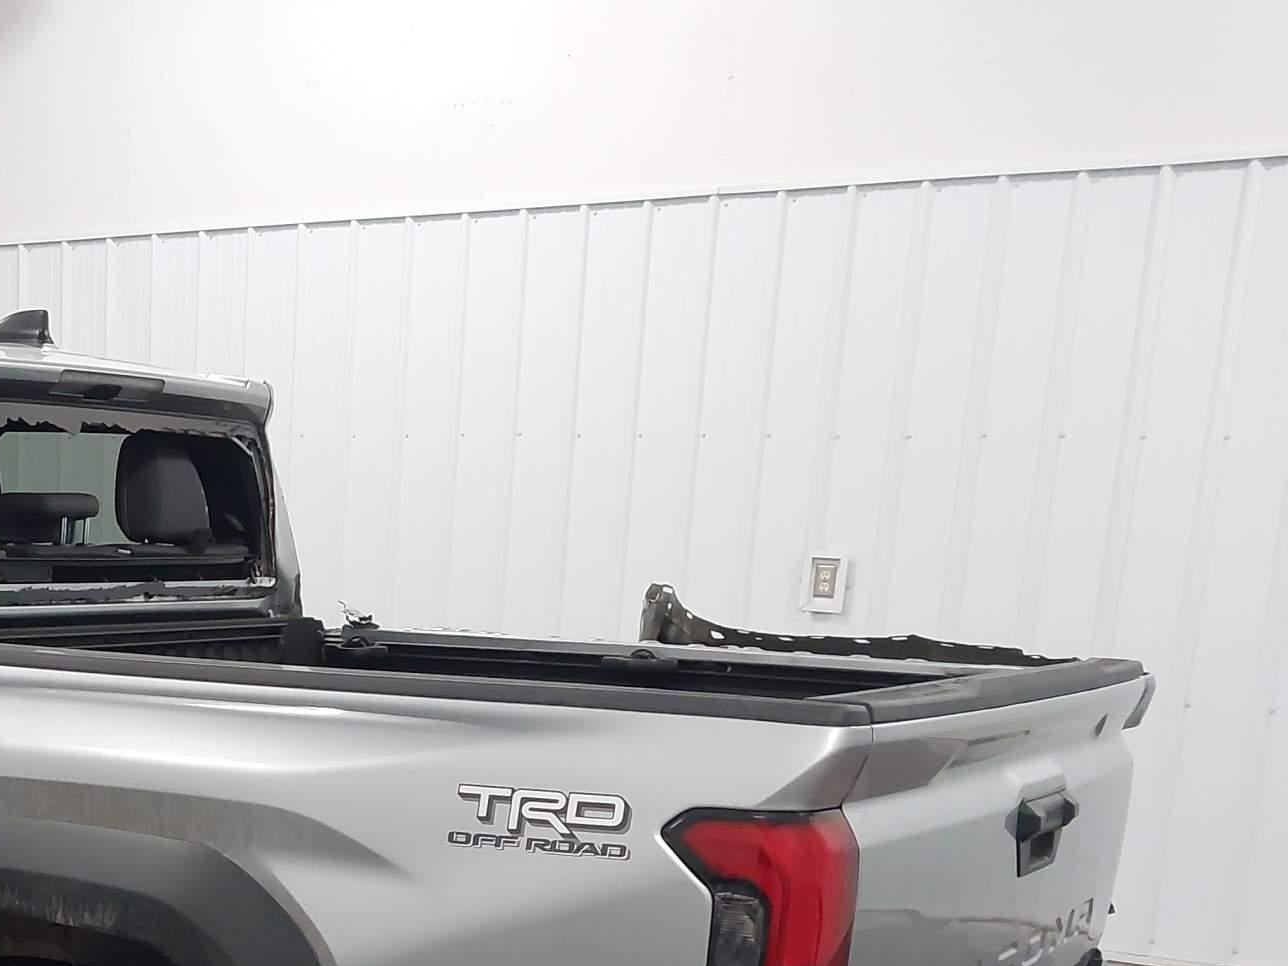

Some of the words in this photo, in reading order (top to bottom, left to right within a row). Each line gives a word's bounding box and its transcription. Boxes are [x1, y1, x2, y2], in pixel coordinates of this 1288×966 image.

[458, 783, 630, 835] TRD
[448, 831, 519, 850] OFF
[525, 838, 630, 860] ROAD
